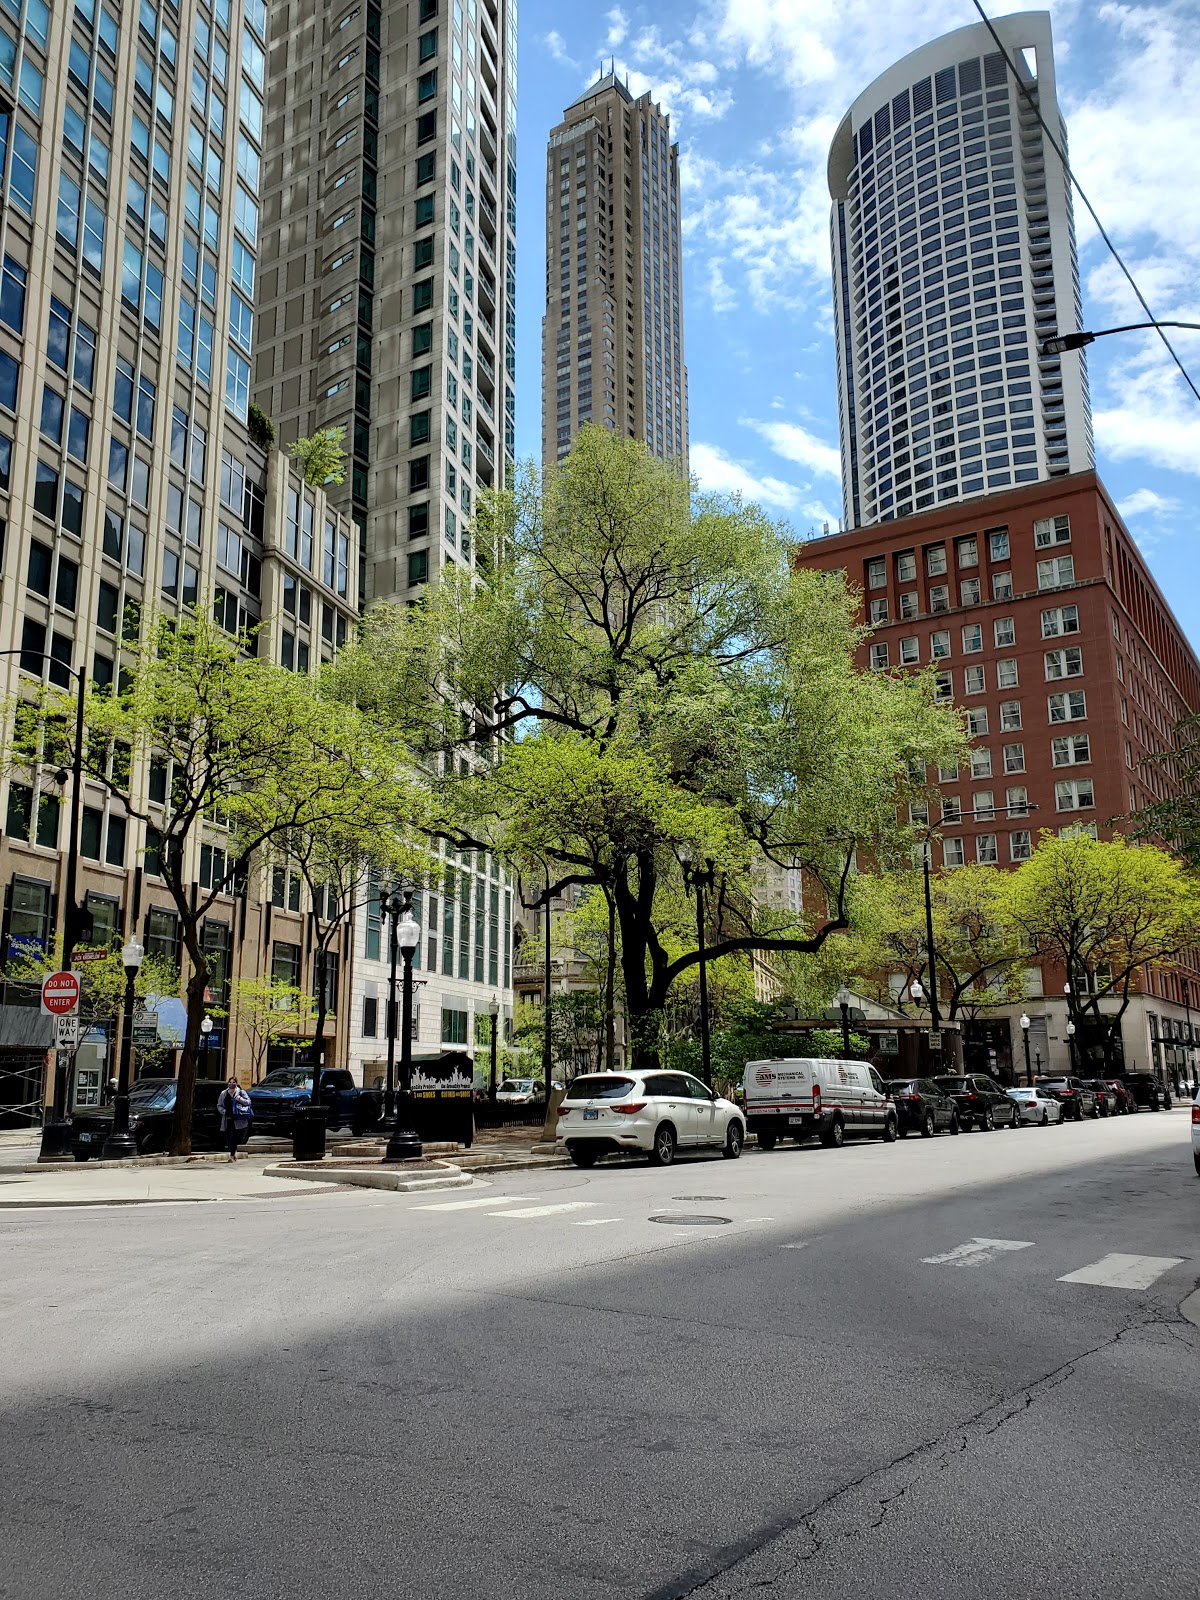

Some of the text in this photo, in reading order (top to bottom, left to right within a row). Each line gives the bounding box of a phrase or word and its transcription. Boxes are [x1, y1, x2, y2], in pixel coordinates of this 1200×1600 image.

[48, 979, 74, 988] DO NOT
[49, 998, 71, 1006] ENTER
[59, 1018, 77, 1027] ONE
[58, 1028, 77, 1037] WAY
[759, 1073, 777, 1081] AMS
